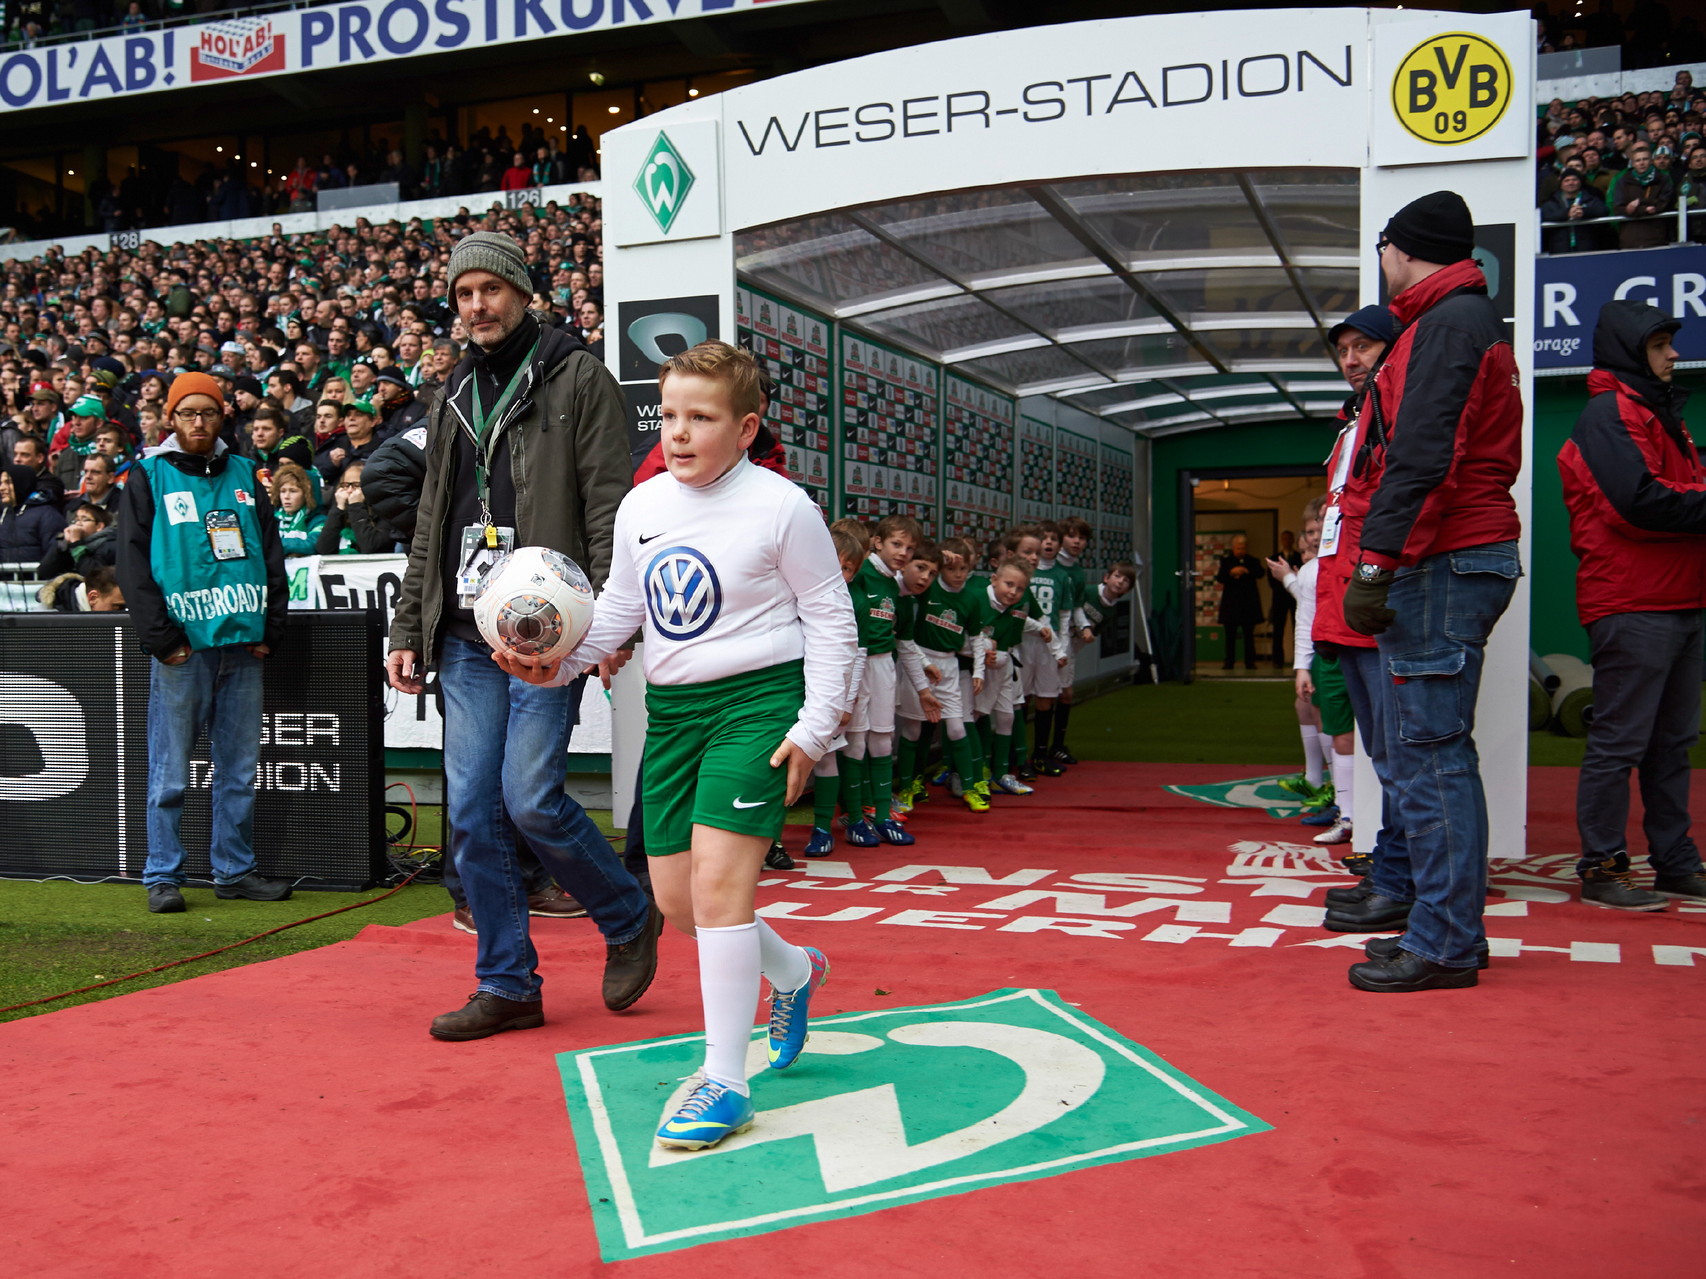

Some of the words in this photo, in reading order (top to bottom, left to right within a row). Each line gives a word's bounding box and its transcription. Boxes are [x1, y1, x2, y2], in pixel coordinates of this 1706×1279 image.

[201, 21, 272, 58] HOL'AB!
[1409, 44, 1498, 113] BVB
[737, 45, 1353, 157] WESER-STADION
[1434, 110, 1466, 133] 09
[508, 189, 540, 209] 126
[112, 232, 139, 250] 128
